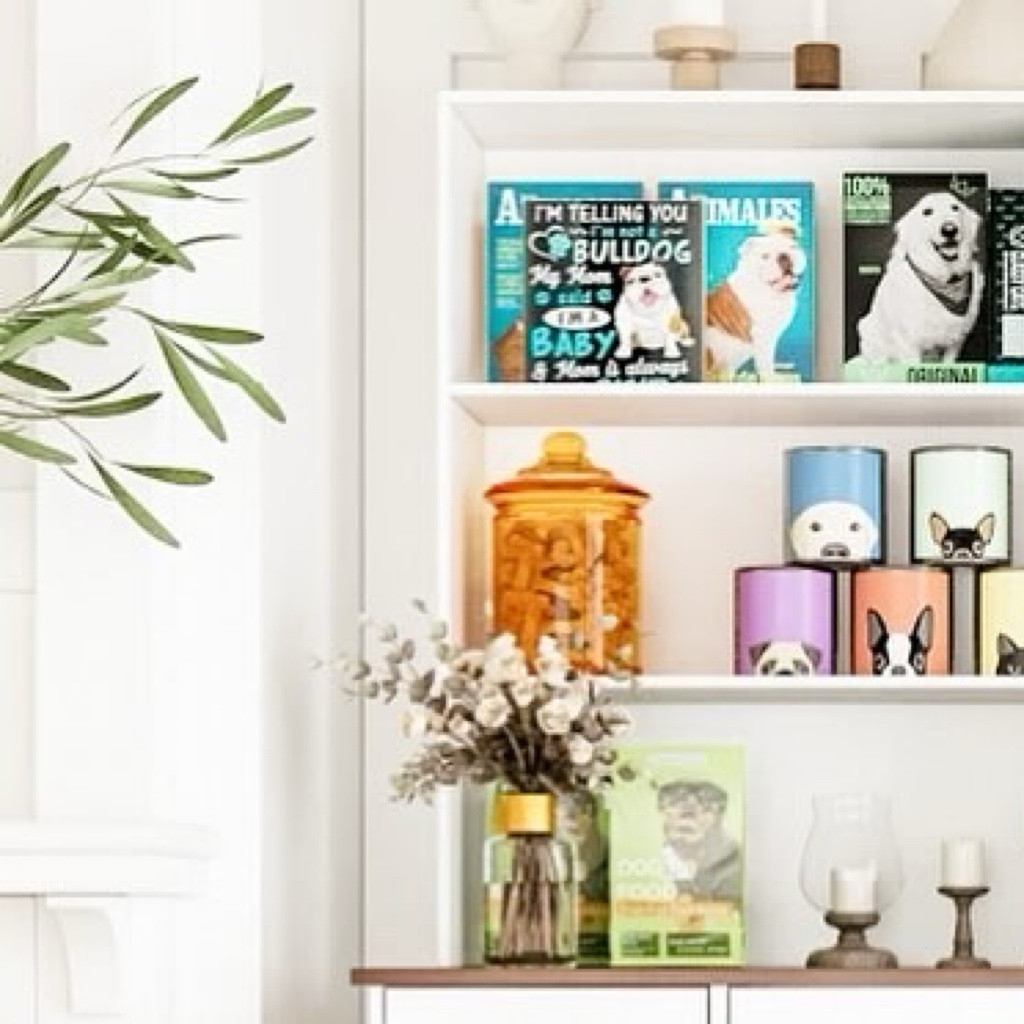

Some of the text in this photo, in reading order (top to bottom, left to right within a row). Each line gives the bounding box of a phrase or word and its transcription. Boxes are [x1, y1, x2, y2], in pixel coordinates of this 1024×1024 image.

[533, 203, 688, 222] I'M TELLING YOU
[573, 238, 692, 264] BULLDOG
[528, 264, 614, 289] My Mom
[530, 326, 615, 359] BABY
[553, 359, 600, 380] Mom
[624, 356, 689, 379] always
